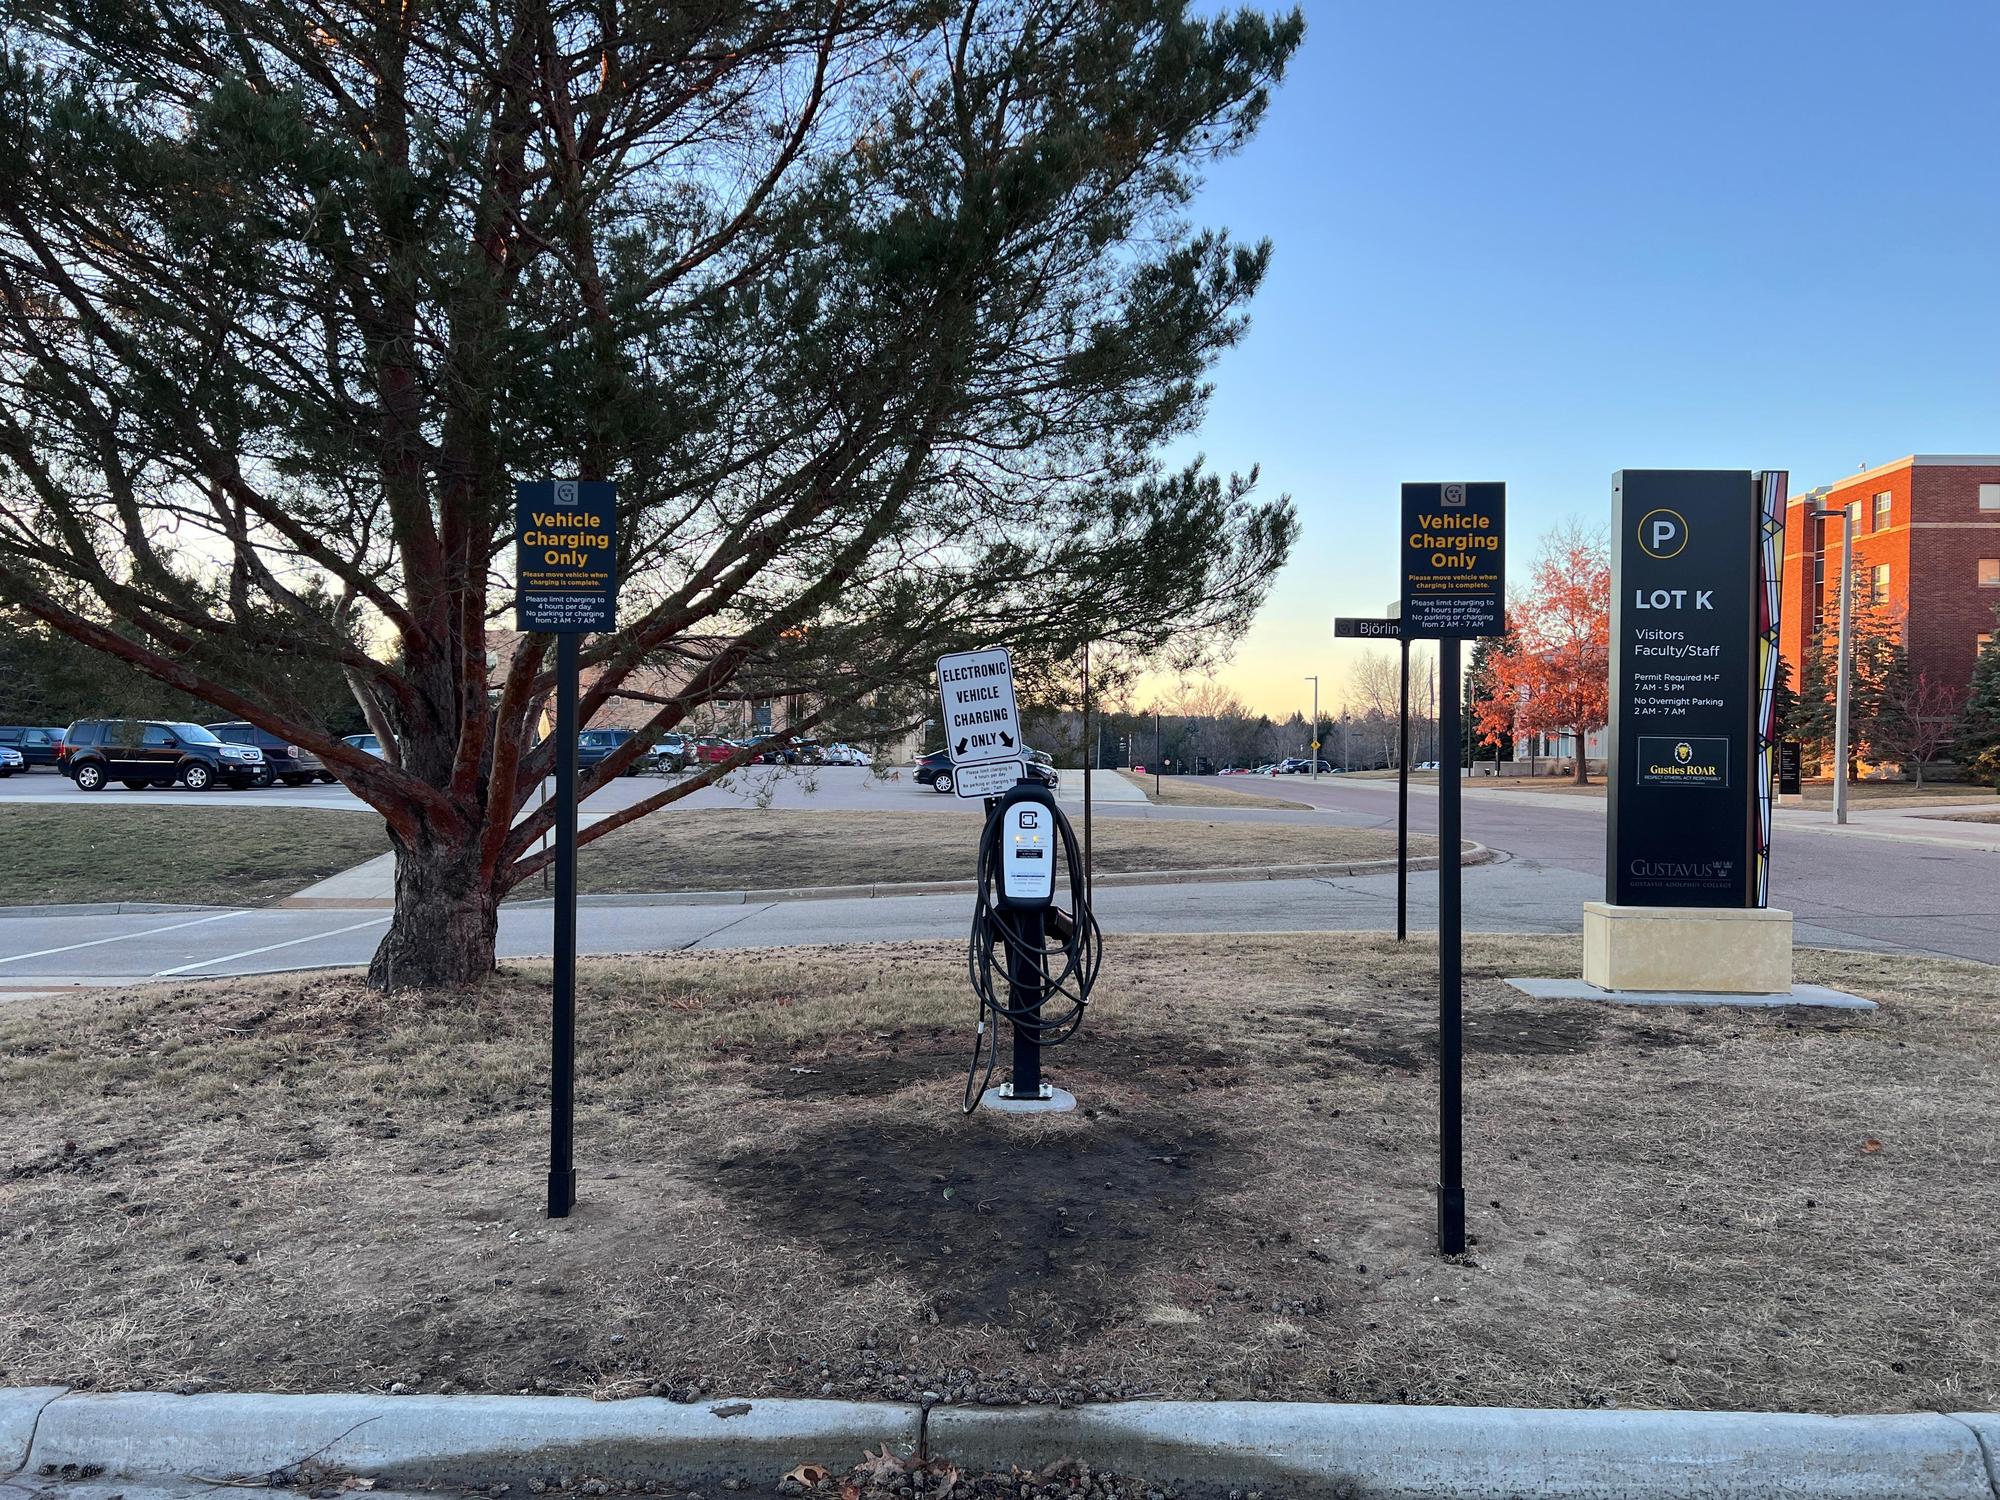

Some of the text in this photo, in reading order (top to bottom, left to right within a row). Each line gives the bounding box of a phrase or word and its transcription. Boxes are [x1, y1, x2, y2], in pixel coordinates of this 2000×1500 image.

[532, 512, 601, 527] Vehicle
[1418, 513, 1490, 529] Vehicle
[523, 531, 609, 549] Charging
[1409, 533, 1499, 550] Charging
[1652, 521, 1676, 549] P
[544, 550, 588, 568] Only
[1431, 552, 1477, 570] Only
[566, 596, 596, 604] charging
[579, 603, 593, 611] day.
[1453, 599, 1485, 607] charging
[1636, 589, 1714, 610] LOT K
[574, 610, 605, 618] charging
[1360, 622, 1401, 636] Björlin
[1635, 629, 1684, 640] Visitors
[1635, 644, 1720, 658] Faculty/Staff
[942, 661, 1007, 683] ELECTRONIC
[1634, 673, 1662, 681] Permit
[1664, 673, 1702, 682] Required
[956, 686, 1000, 703] VEHICLE
[1634, 697, 1724, 707] No Overnight Parking
[954, 708, 1008, 727] CHARGING
[971, 732, 997, 748] ONLY
[1650, 764, 1716, 775] Gusties ROAR
[1630, 859, 1713, 876] GUSTAVUS
